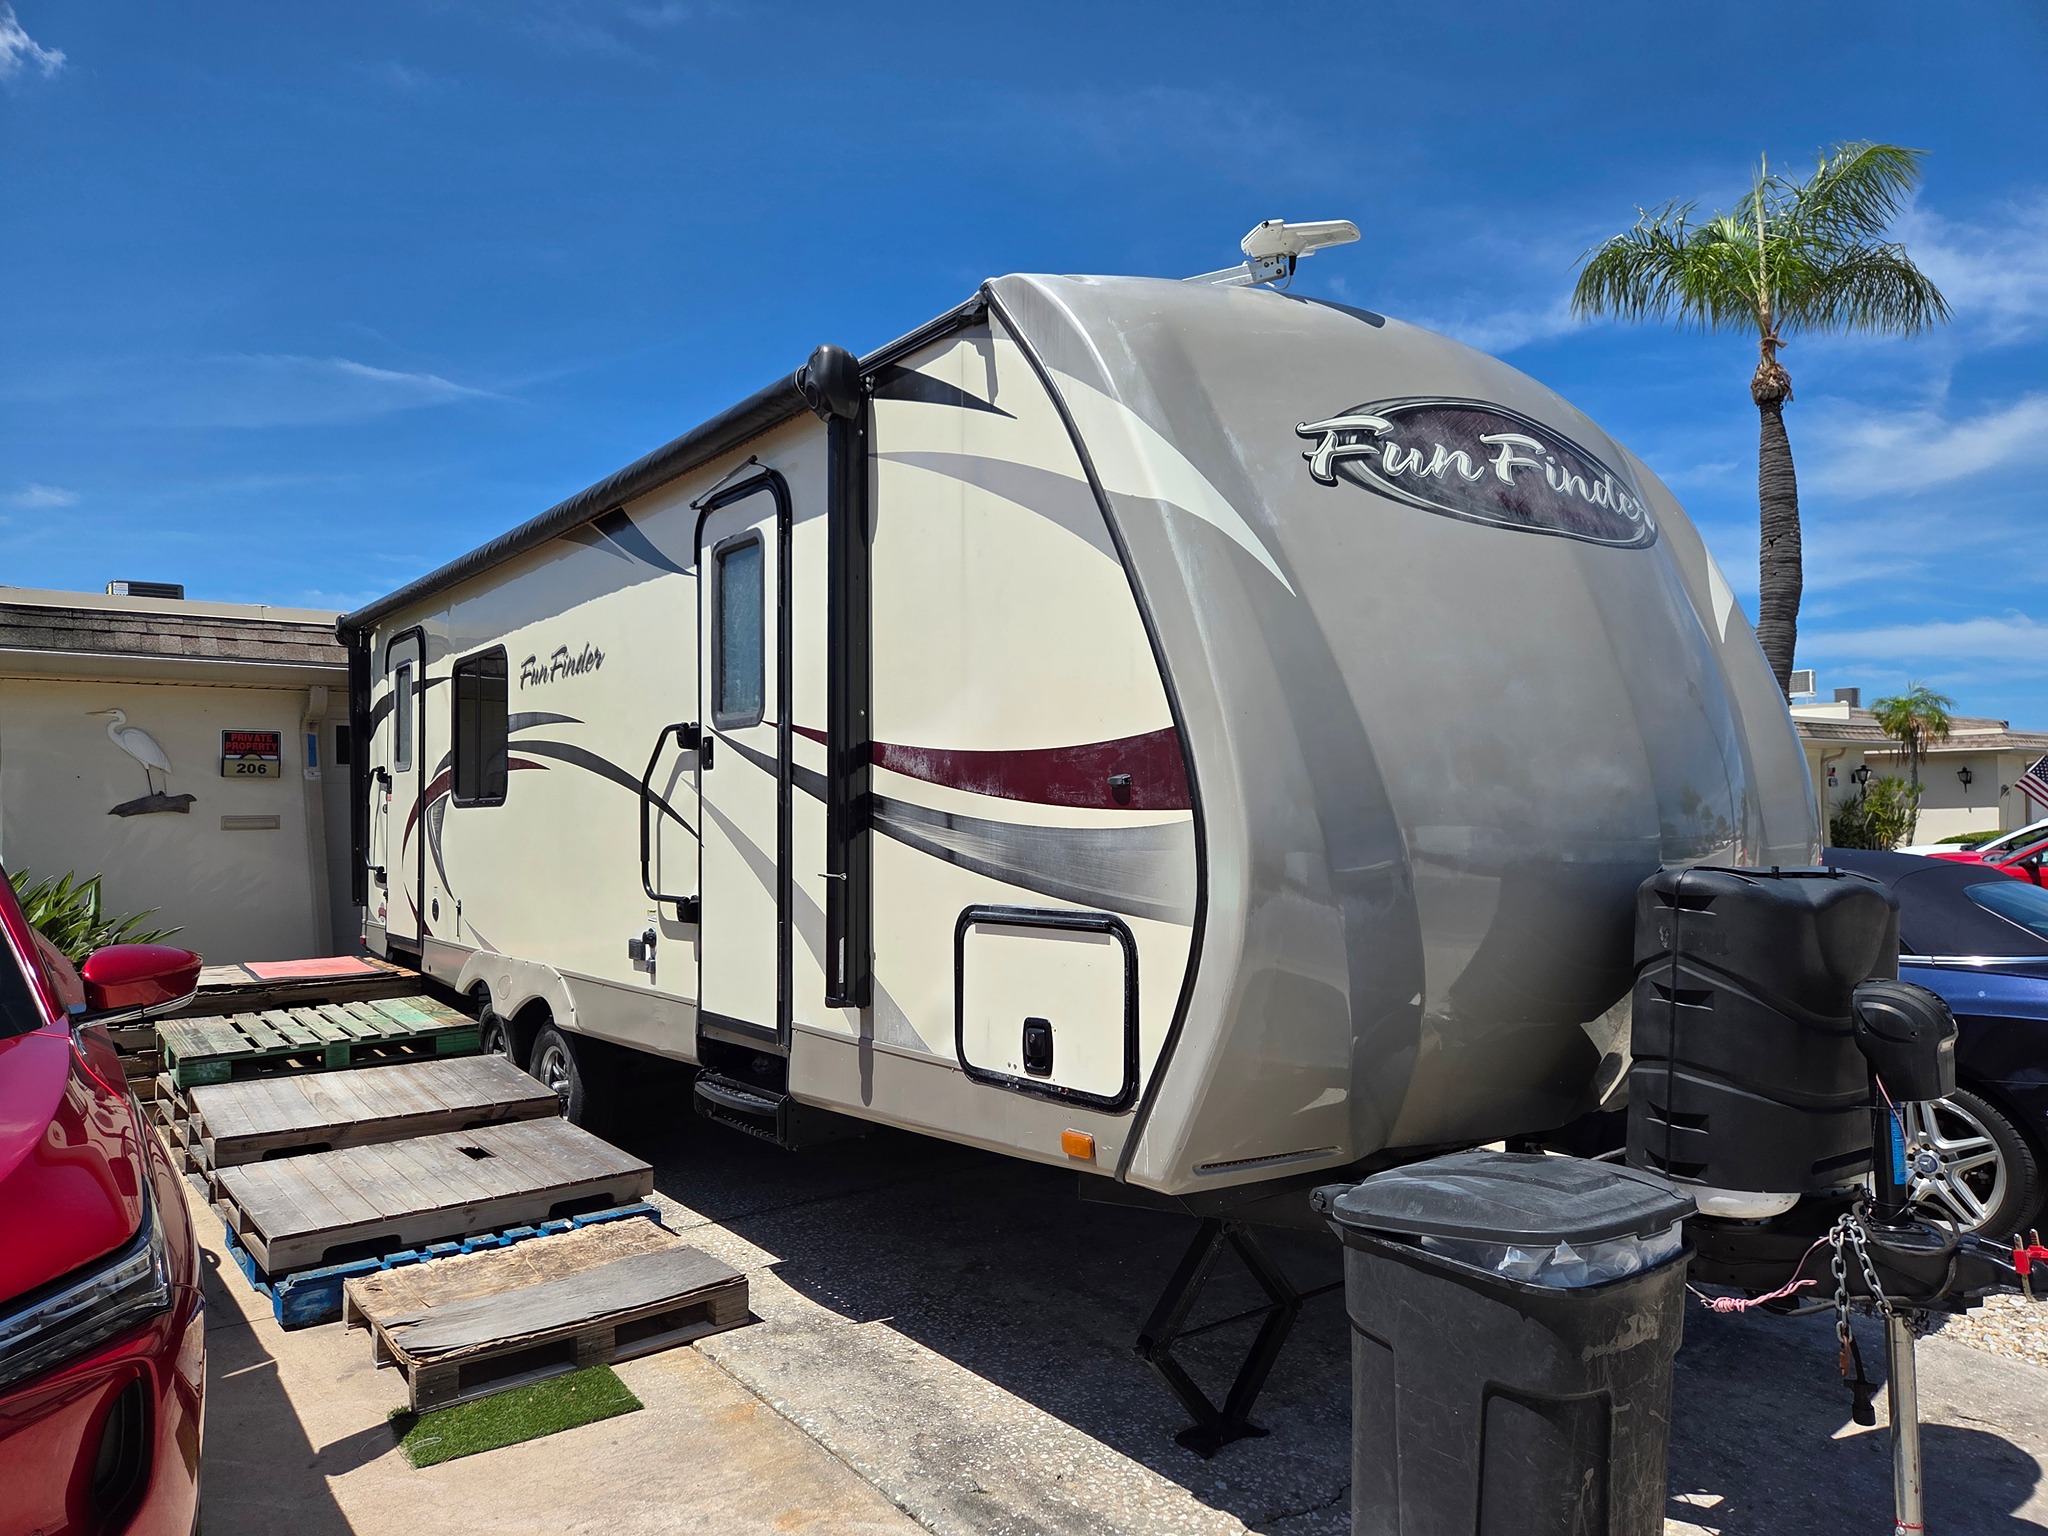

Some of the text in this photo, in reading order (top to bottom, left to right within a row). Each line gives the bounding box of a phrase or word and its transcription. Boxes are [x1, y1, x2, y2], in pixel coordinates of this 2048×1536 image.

[1296, 415, 1656, 532] Fun Finder
[520, 641, 605, 690] Fun Finder
[231, 733, 273, 742] PRIVATE
[225, 742, 278, 751] PROPERTY
[236, 763, 267, 774] 206
